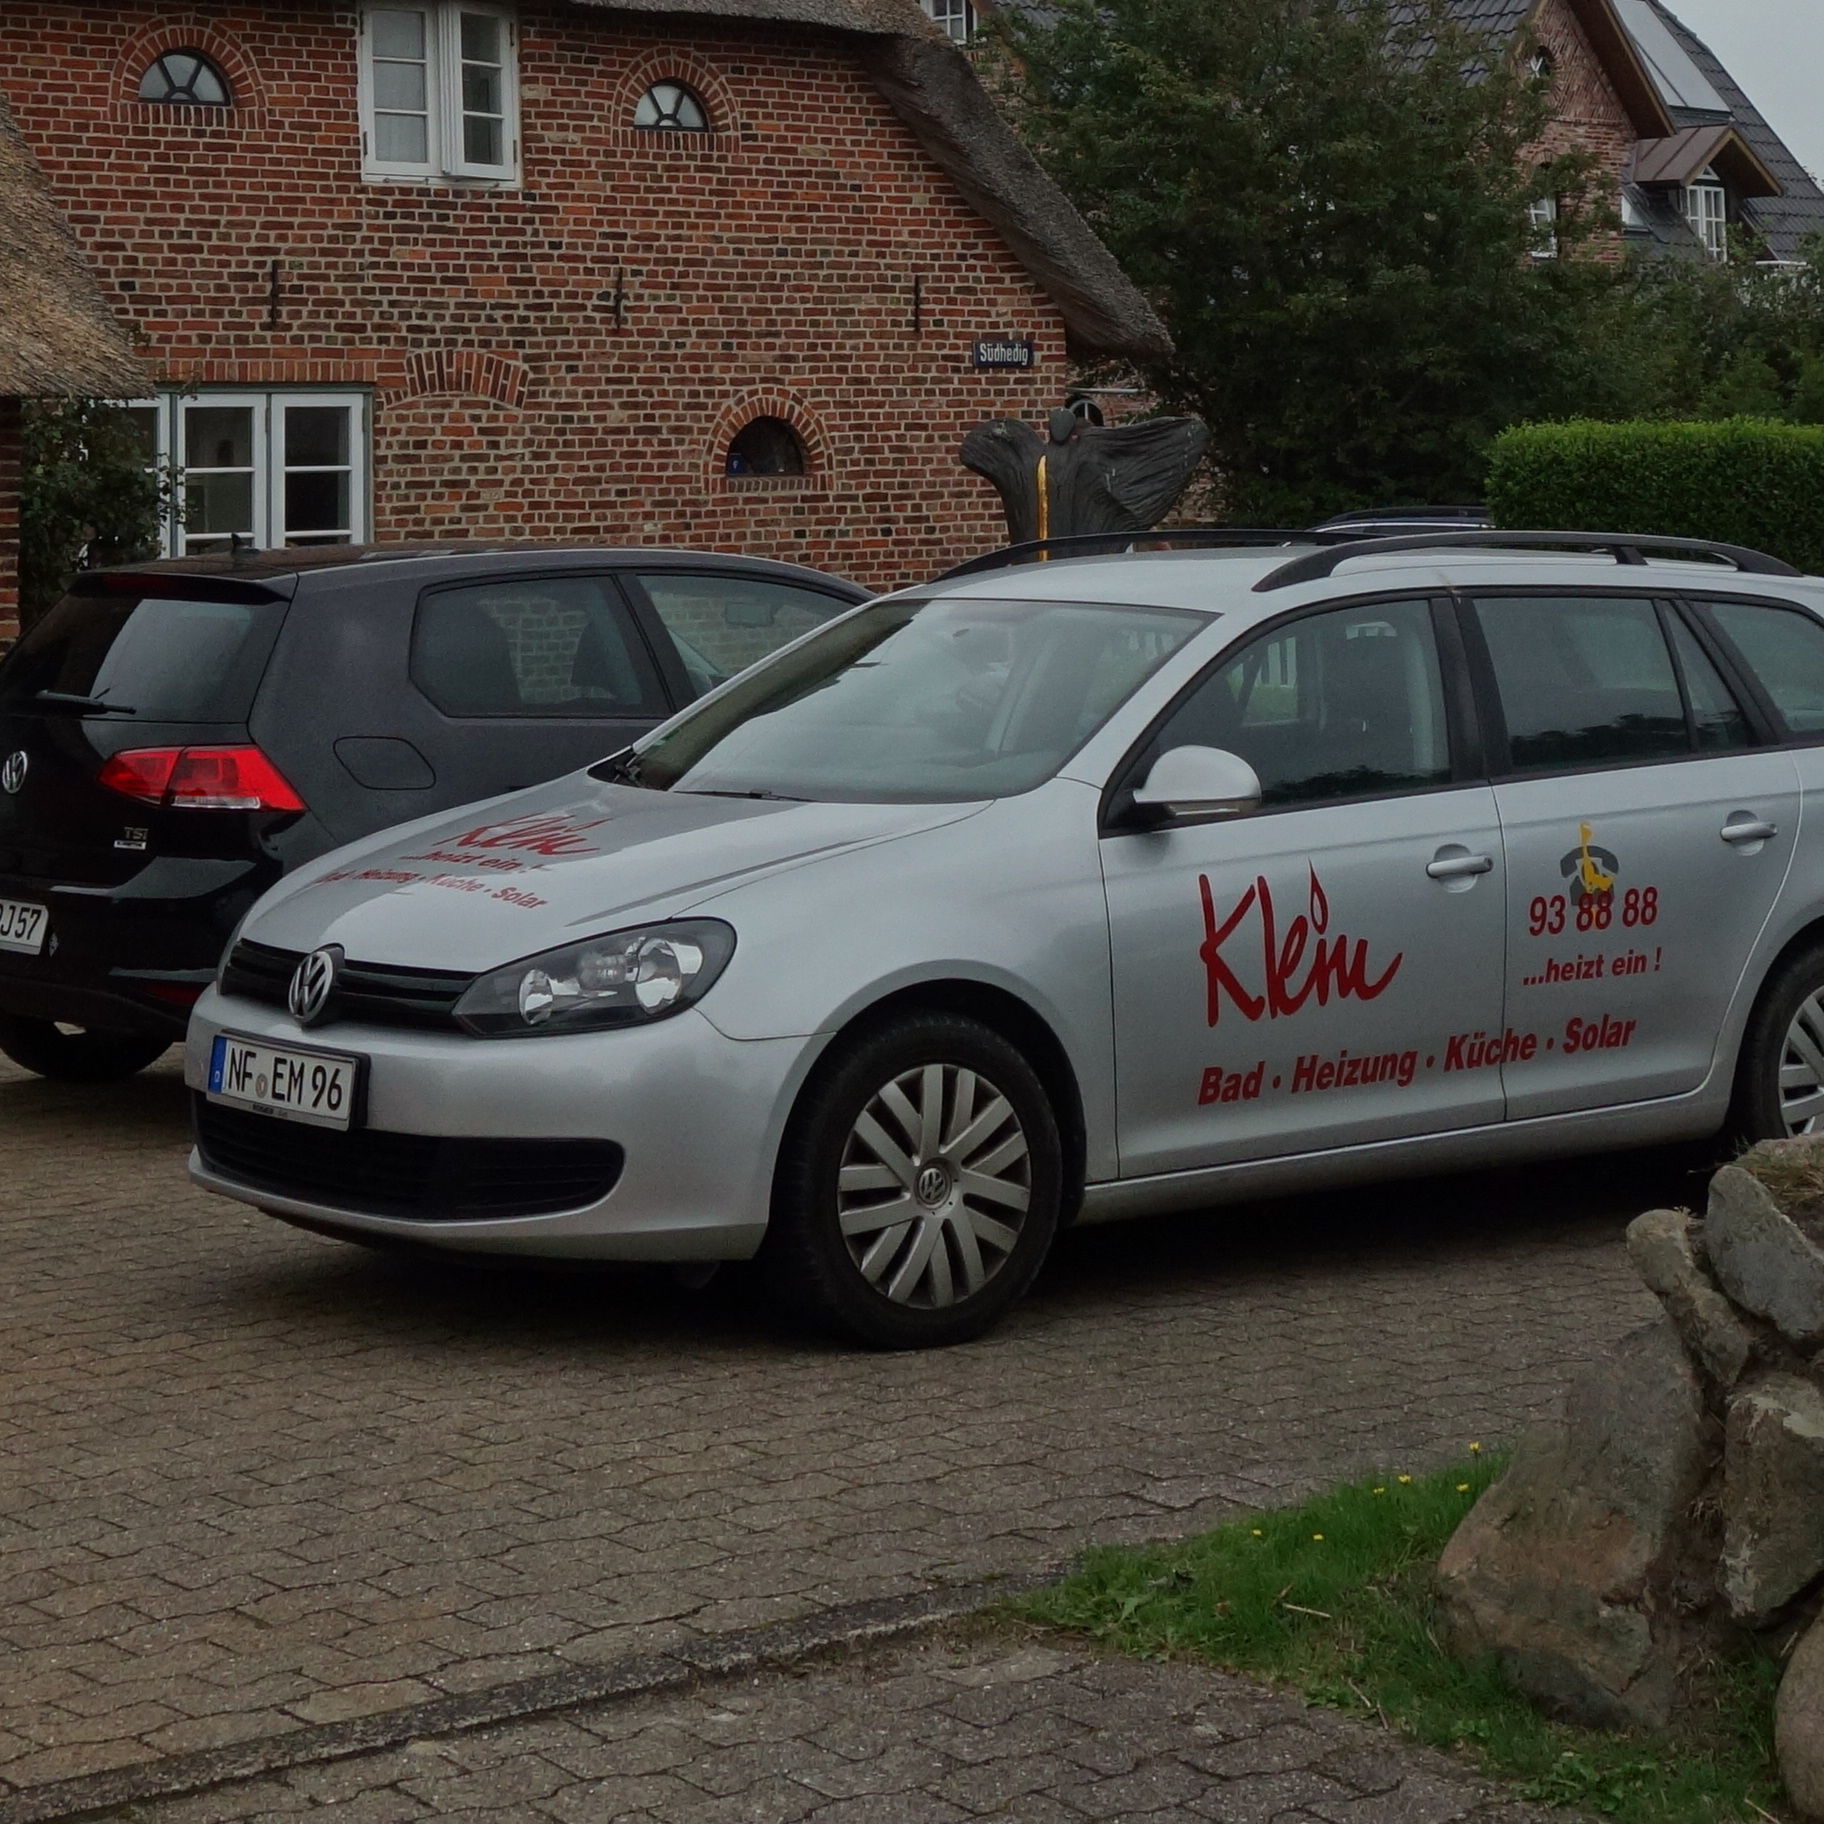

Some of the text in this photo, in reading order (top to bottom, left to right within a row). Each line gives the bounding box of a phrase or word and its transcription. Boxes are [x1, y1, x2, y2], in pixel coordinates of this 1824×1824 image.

[980, 342, 1029, 366] Südhedig
[491, 885, 548, 909] Solar
[1529, 886, 1658, 936] 93 88 88
[1198, 857, 1404, 1028] Klein
[1611, 948, 1648, 977] ein
[228, 1047, 257, 1092] NF
[272, 1056, 305, 1105] EM
[311, 1065, 343, 1111] 96
[1198, 1013, 1637, 1105] Bad Heizung Küche Solar
